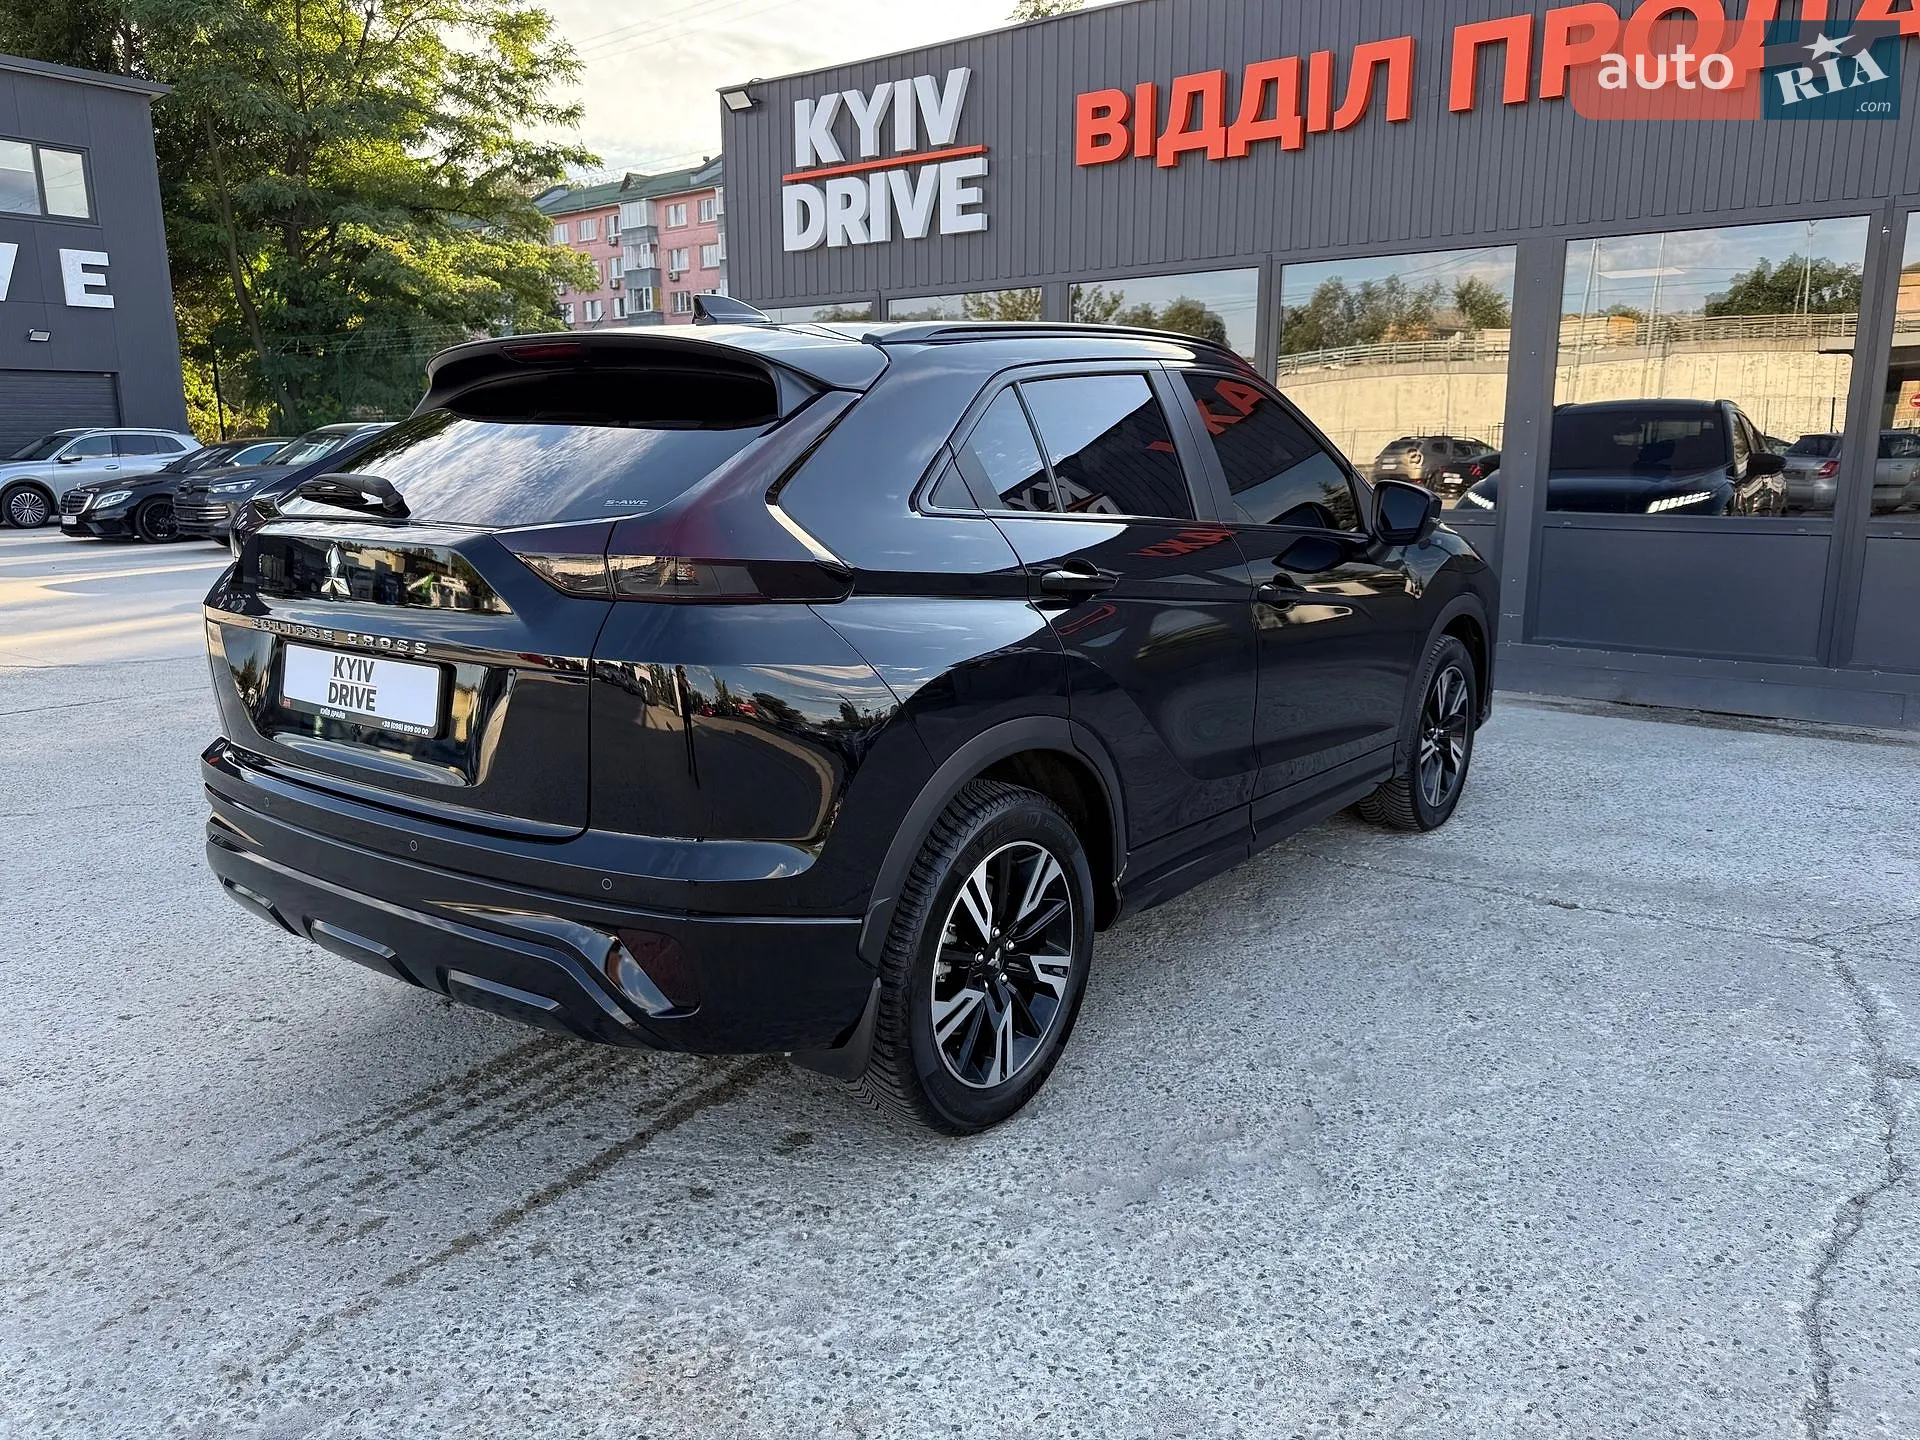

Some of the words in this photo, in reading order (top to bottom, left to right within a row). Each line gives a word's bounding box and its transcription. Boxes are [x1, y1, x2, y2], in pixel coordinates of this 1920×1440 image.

[794, 66, 972, 168] KYIV
[1075, 35, 1414, 168] ВІДДІЛ
[782, 157, 988, 252] DRIVE
[251, 618, 335, 641] ECLIPSE
[347, 632, 428, 655] CROSS
[333, 655, 375, 683] KYIV
[328, 681, 377, 712] DRIVE
